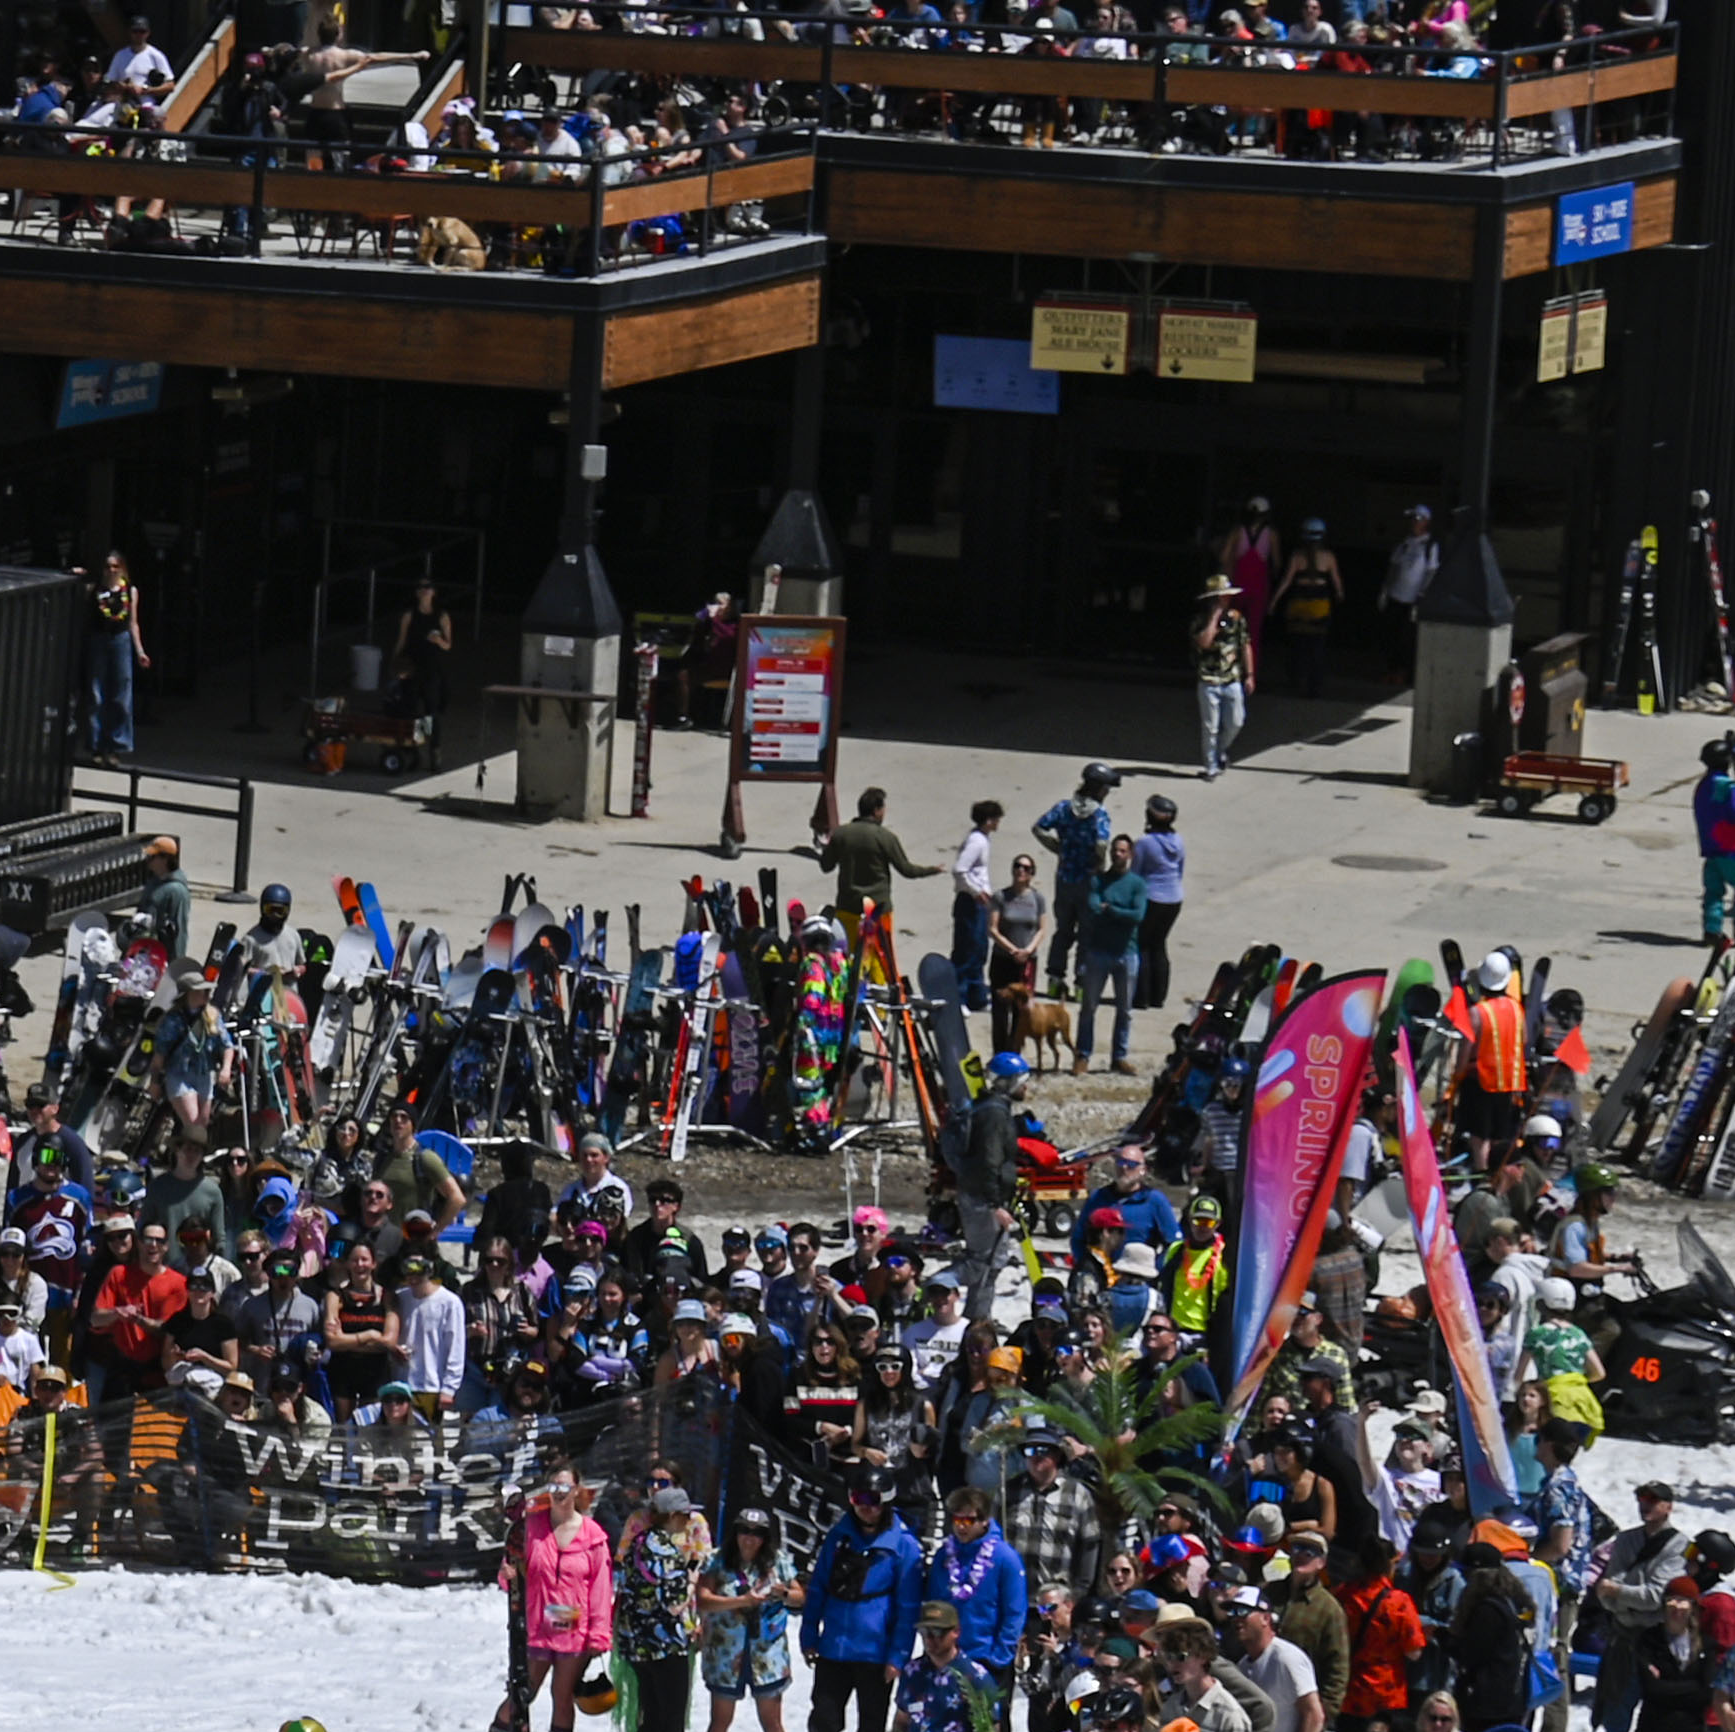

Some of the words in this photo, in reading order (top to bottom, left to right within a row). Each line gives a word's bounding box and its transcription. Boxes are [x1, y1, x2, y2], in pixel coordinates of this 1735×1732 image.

[1289, 1033, 1344, 1221] SPRING
[1630, 1357, 1661, 1382] 46
[223, 1419, 549, 1491] Winter
